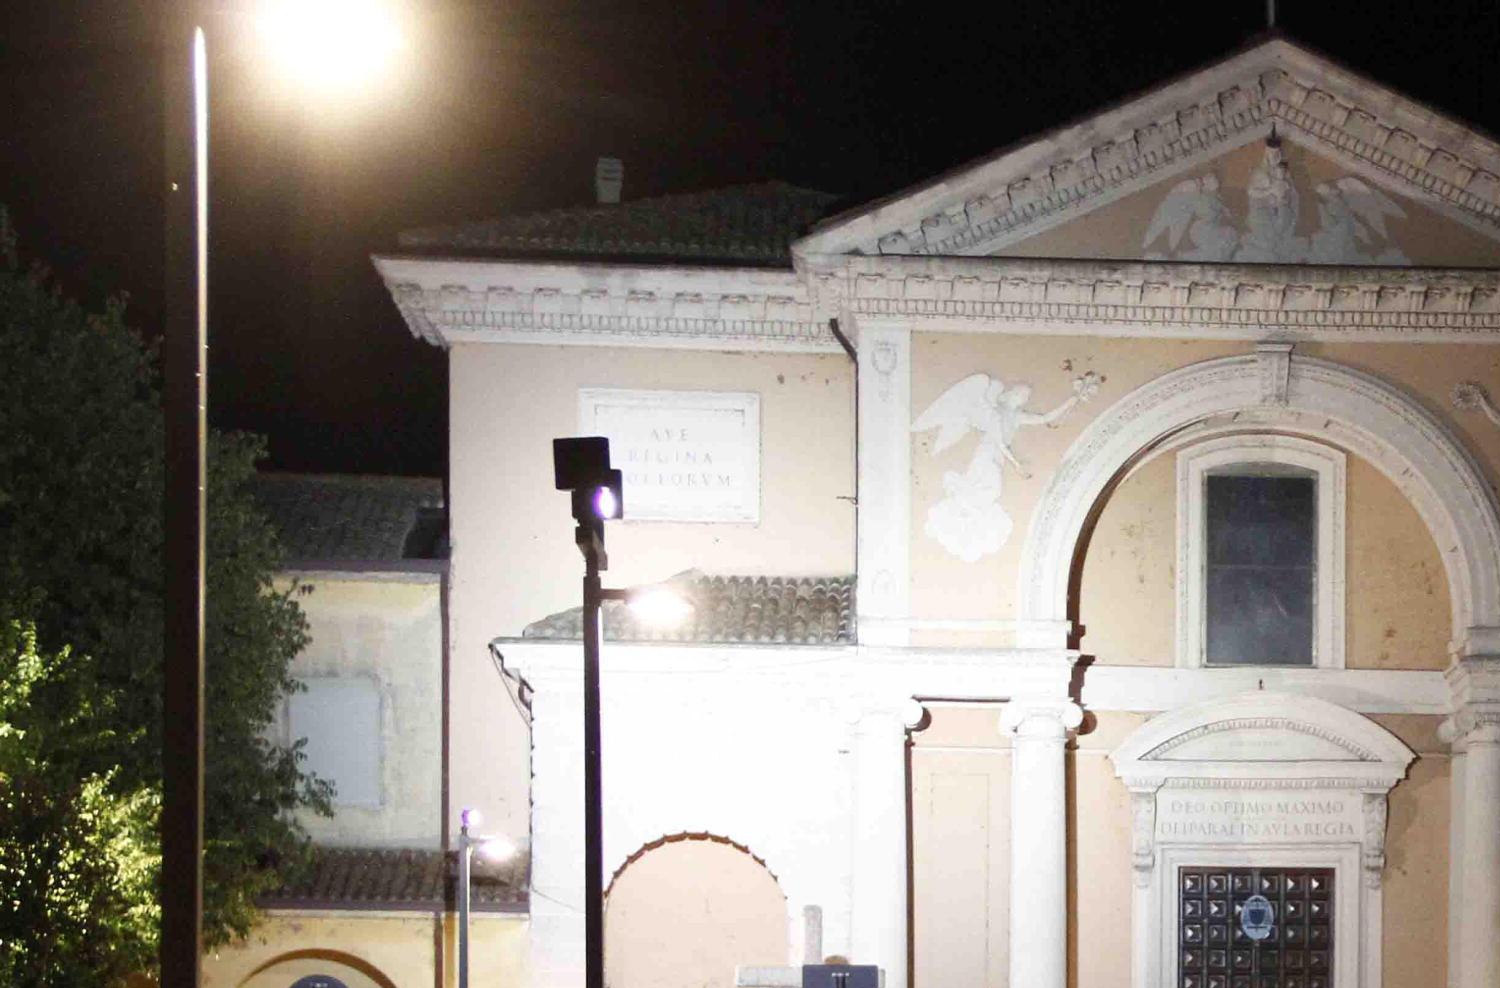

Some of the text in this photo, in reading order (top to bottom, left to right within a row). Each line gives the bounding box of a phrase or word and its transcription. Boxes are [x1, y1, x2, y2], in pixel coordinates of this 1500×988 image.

[650, 428, 688, 442] AVE
[1171, 800, 1344, 815] DEO OPTIMO MAXIMO
[1303, 822, 1355, 836] REGIA
